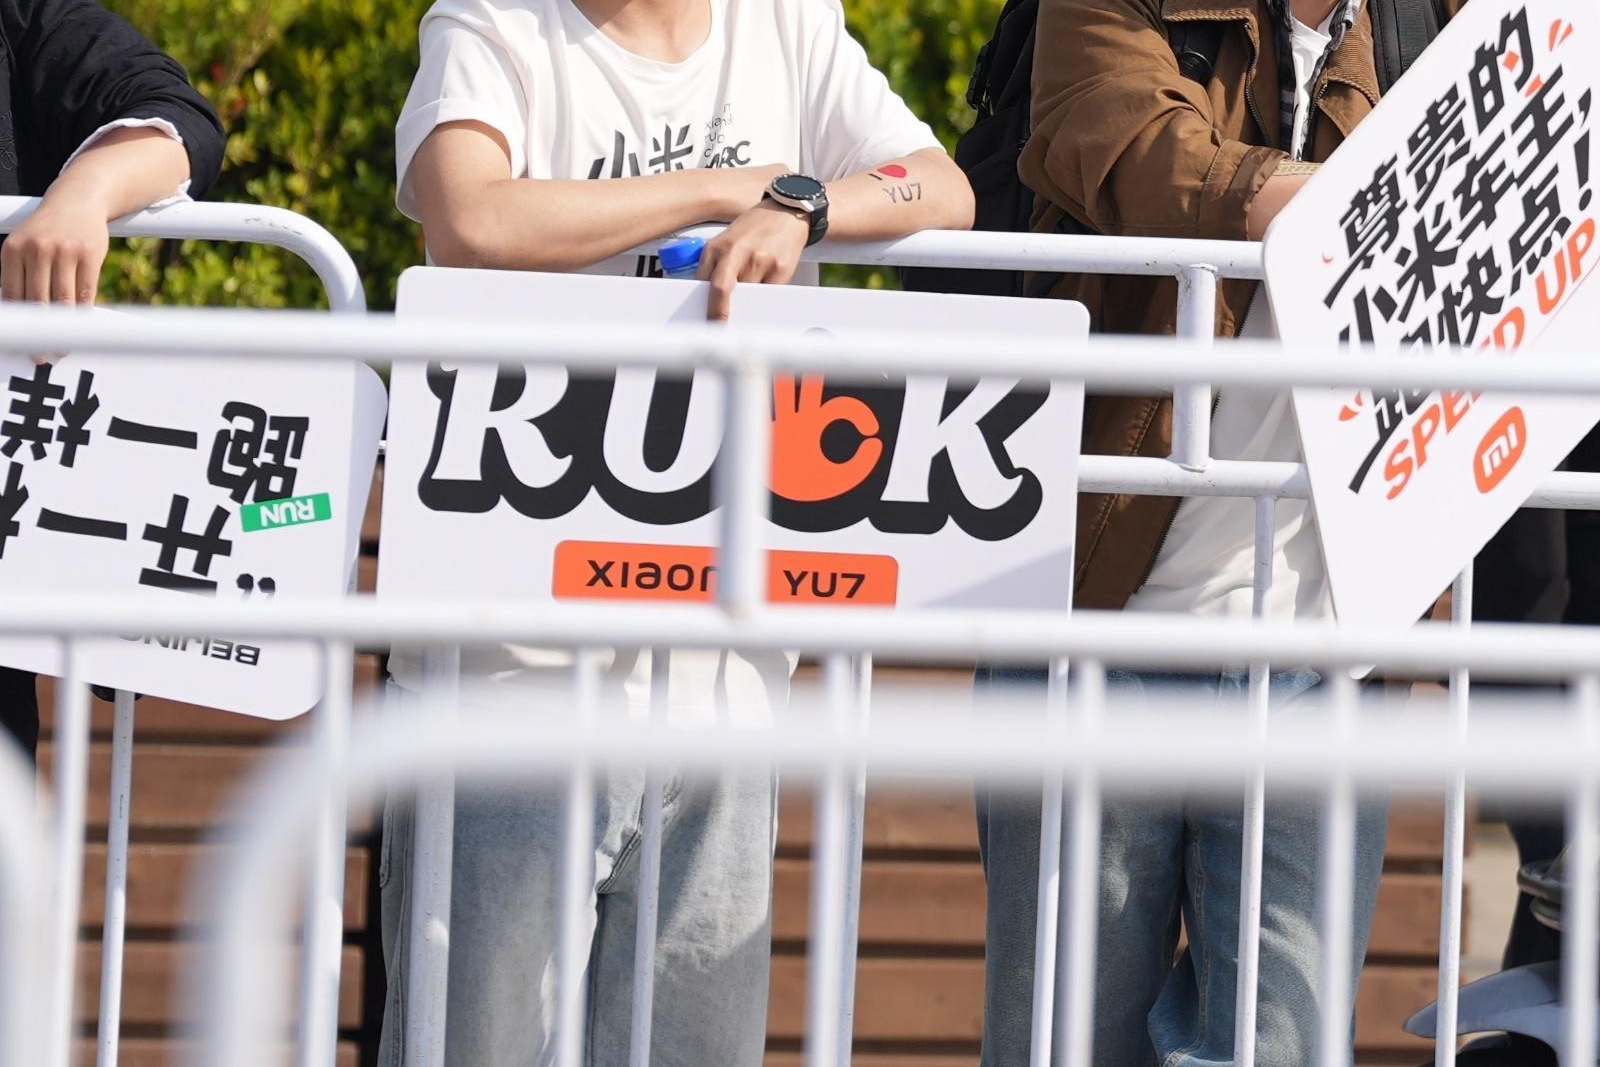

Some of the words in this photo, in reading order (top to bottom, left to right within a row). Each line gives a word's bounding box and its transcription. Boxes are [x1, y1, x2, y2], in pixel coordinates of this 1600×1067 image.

[1324, 5, 1534, 309] 尊贵的
[882, 182, 922, 204] YU7
[1535, 217, 1596, 316] UP
[260, 496, 316, 528] RUN
[783, 569, 866, 599] YU7
